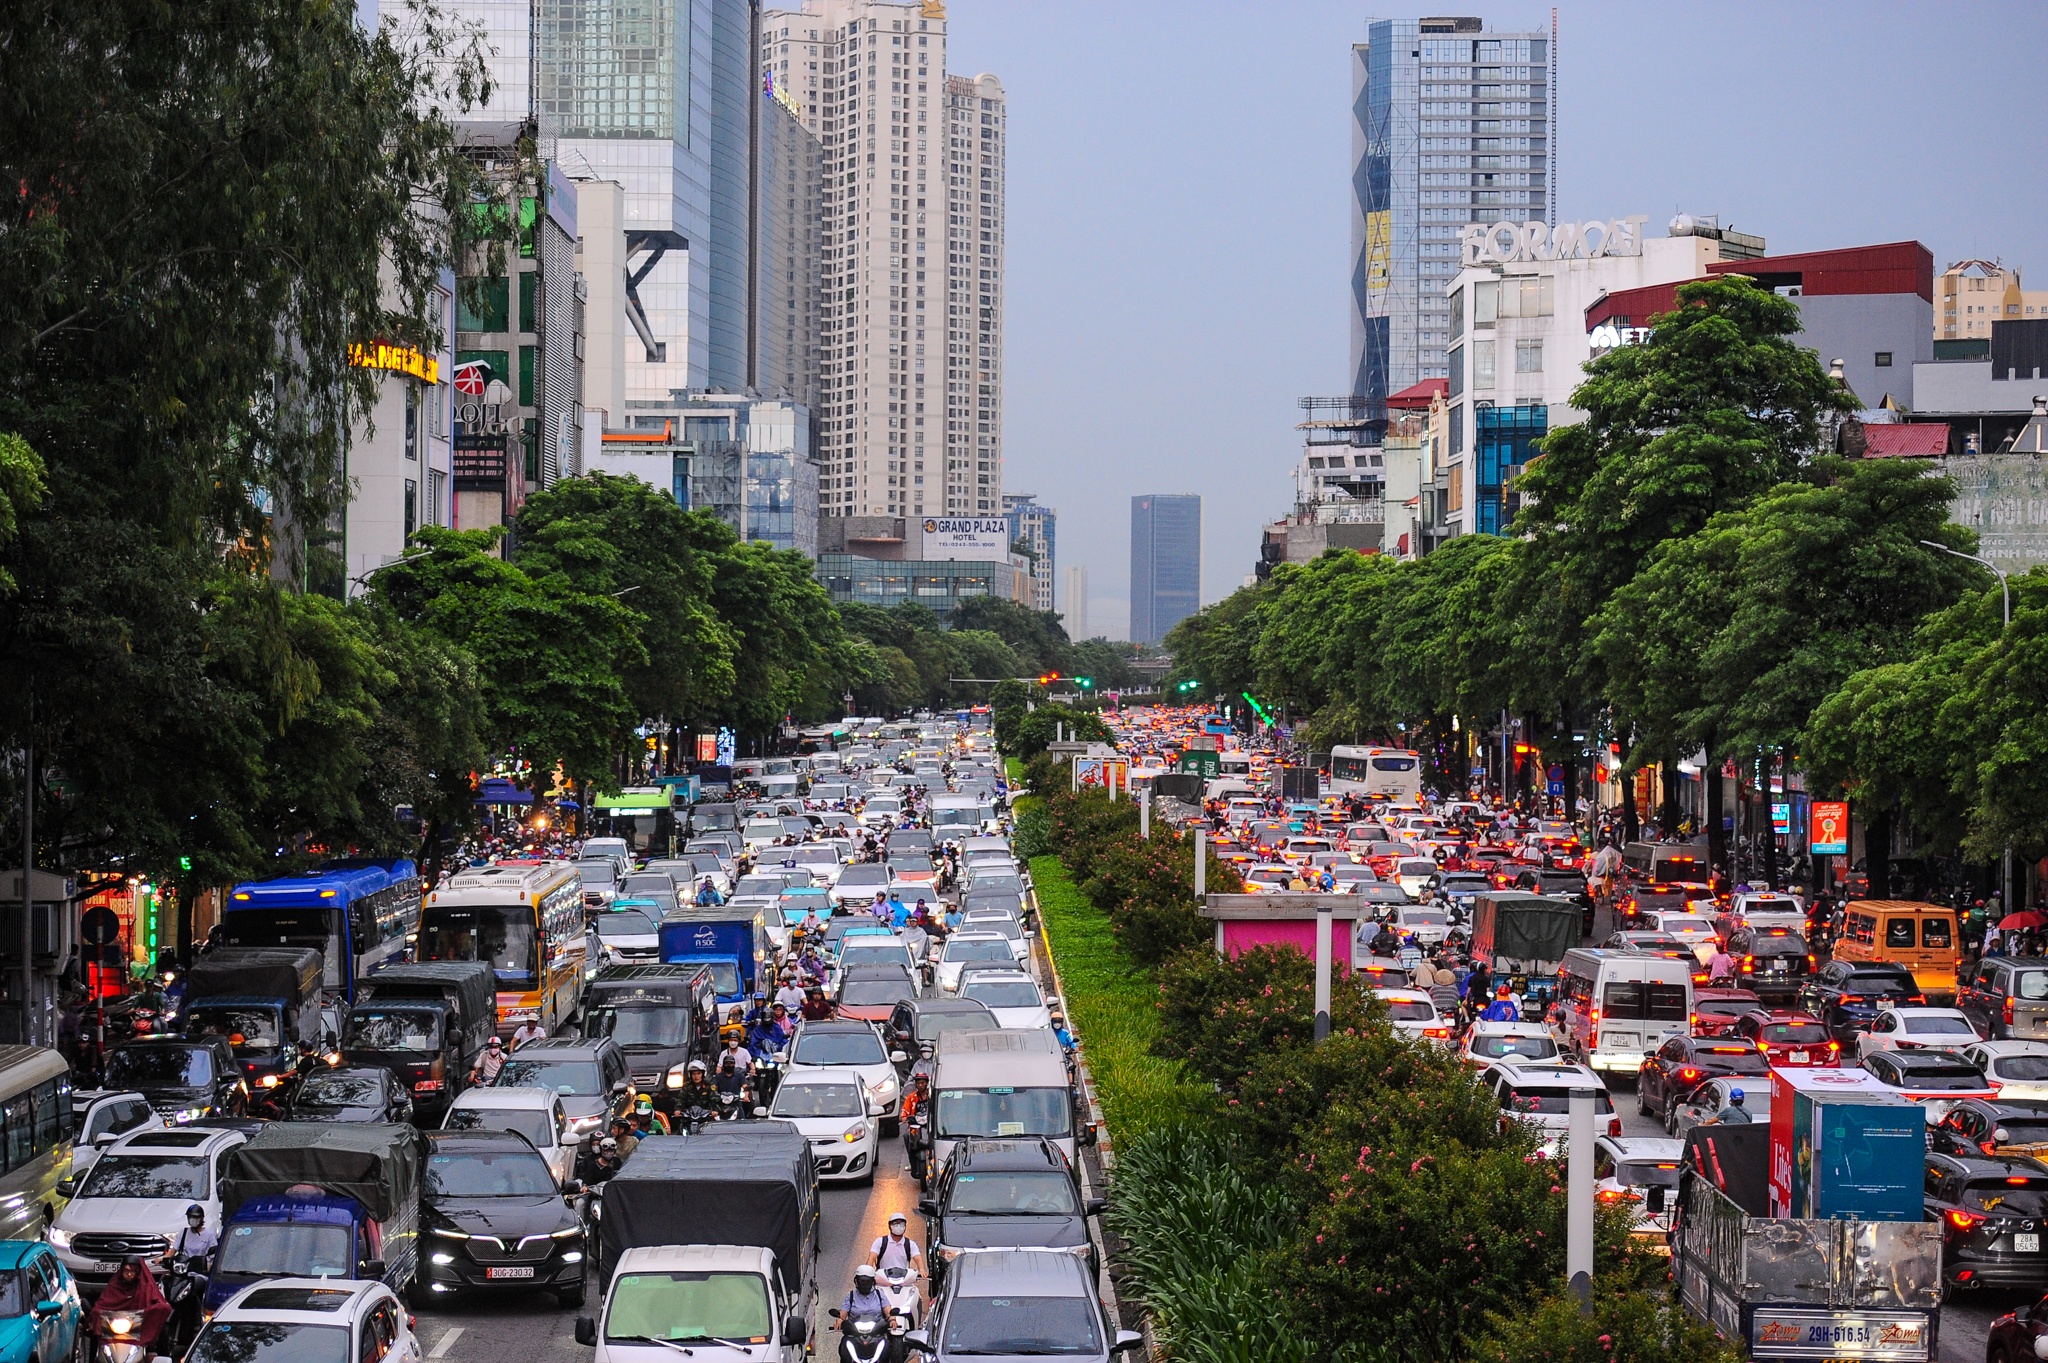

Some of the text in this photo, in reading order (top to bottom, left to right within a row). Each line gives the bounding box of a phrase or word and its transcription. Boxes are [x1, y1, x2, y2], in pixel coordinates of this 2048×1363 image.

[1462, 215, 1648, 264] FORMAT
[938, 520, 1005, 533] GRAND PLAZA
[1964, 895, 1970, 903] 7
[1774, 1139, 1792, 1193] Life's
[493, 1268, 533, 1277] 30G-230.32
[1808, 1325, 1870, 1343] 29H-616.54
